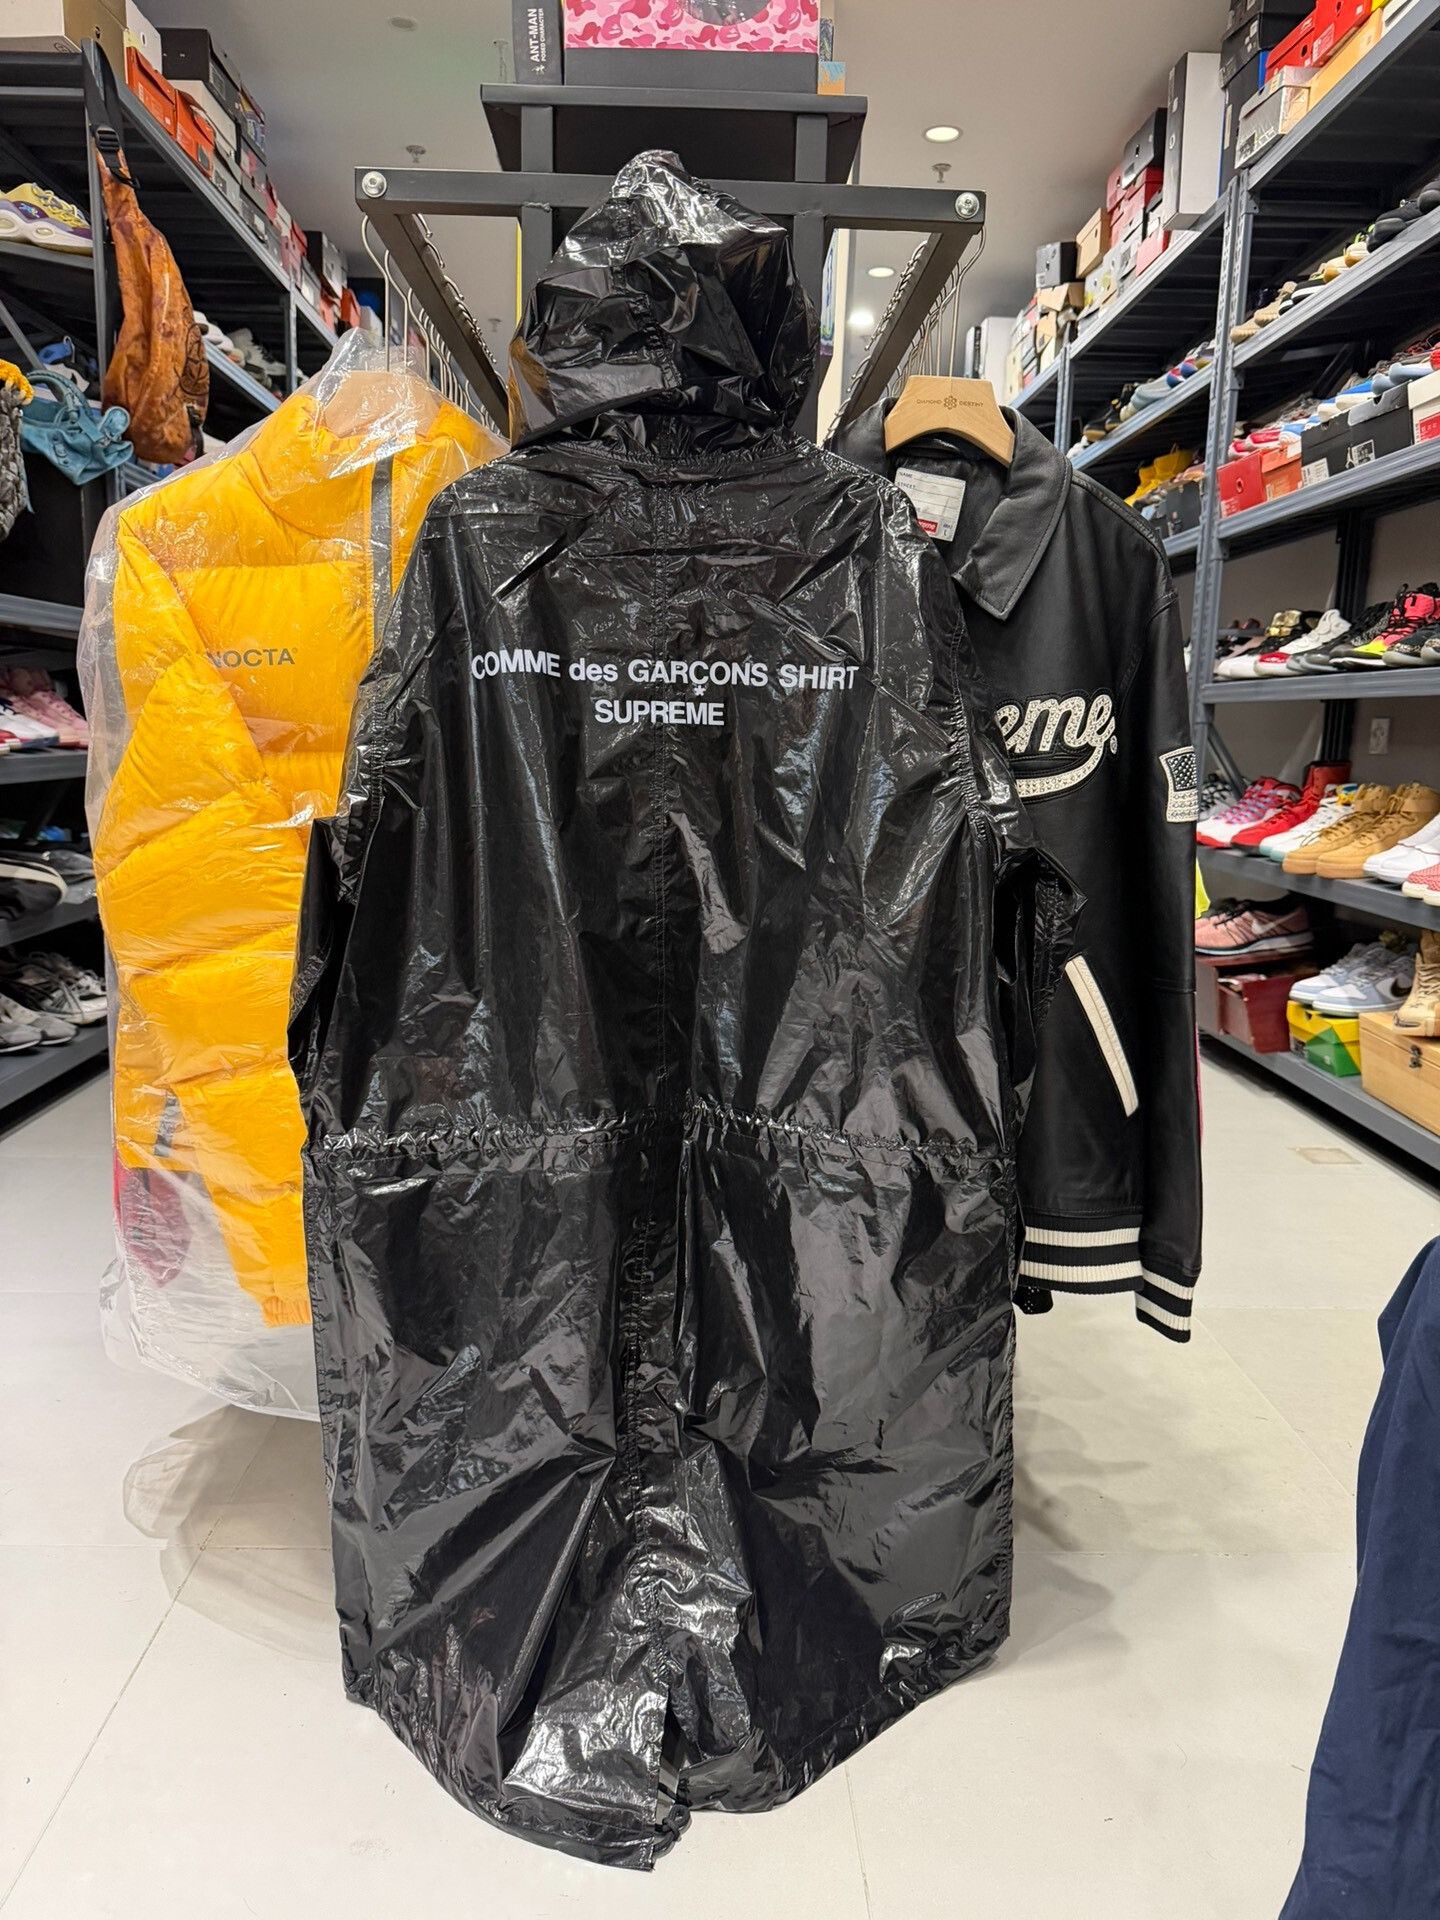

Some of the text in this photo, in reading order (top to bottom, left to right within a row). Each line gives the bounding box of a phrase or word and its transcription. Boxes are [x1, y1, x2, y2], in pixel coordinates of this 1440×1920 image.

[527, 8, 540, 62] ANT-MAN
[206, 648, 295, 668] NOCTA
[471, 649, 561, 680] COMME
[568, 657, 619, 682] des
[778, 663, 860, 690] SHIRT
[594, 699, 725, 726] SUPREME
[995, 694, 1115, 754] eme
